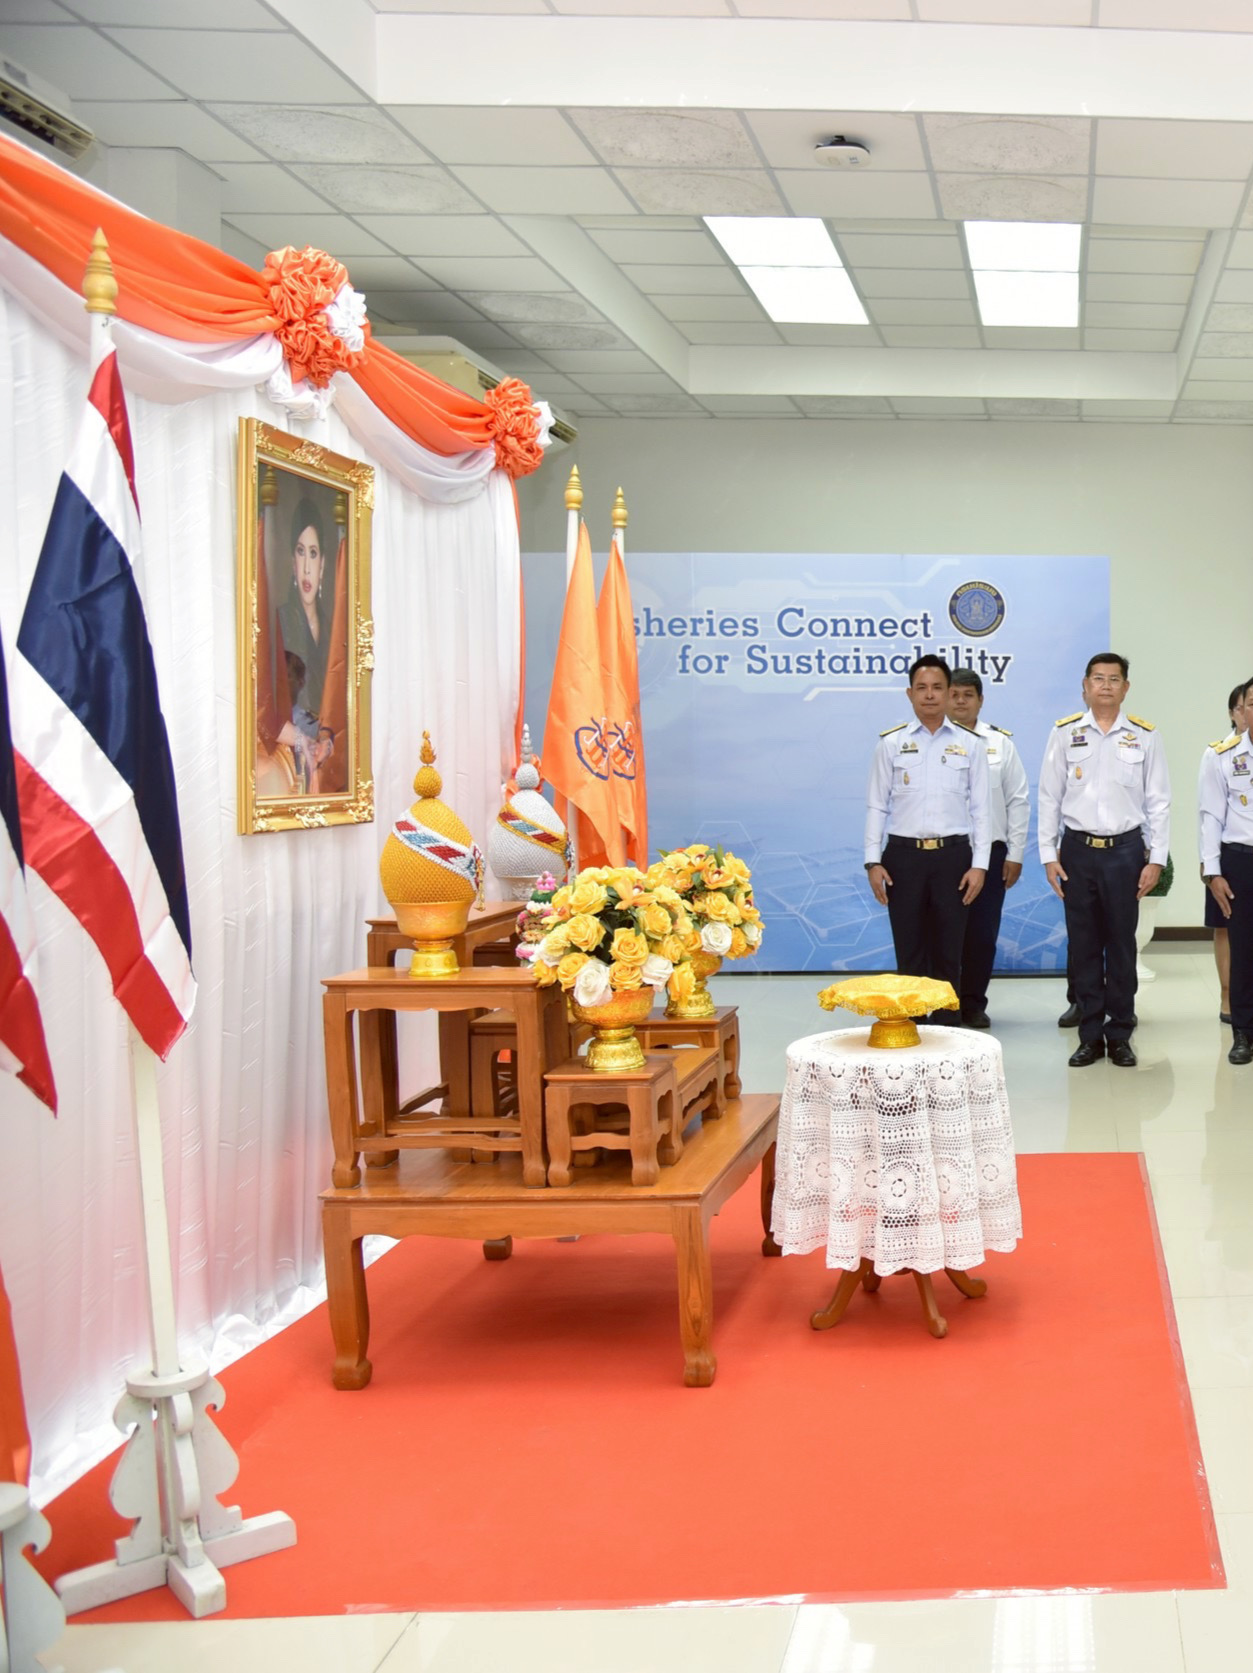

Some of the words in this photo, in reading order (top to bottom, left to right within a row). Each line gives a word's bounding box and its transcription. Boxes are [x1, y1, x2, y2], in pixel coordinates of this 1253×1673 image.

[776, 607, 932, 638] Connect
[678, 644, 730, 675] for
[746, 643, 1012, 683] Sustainality
